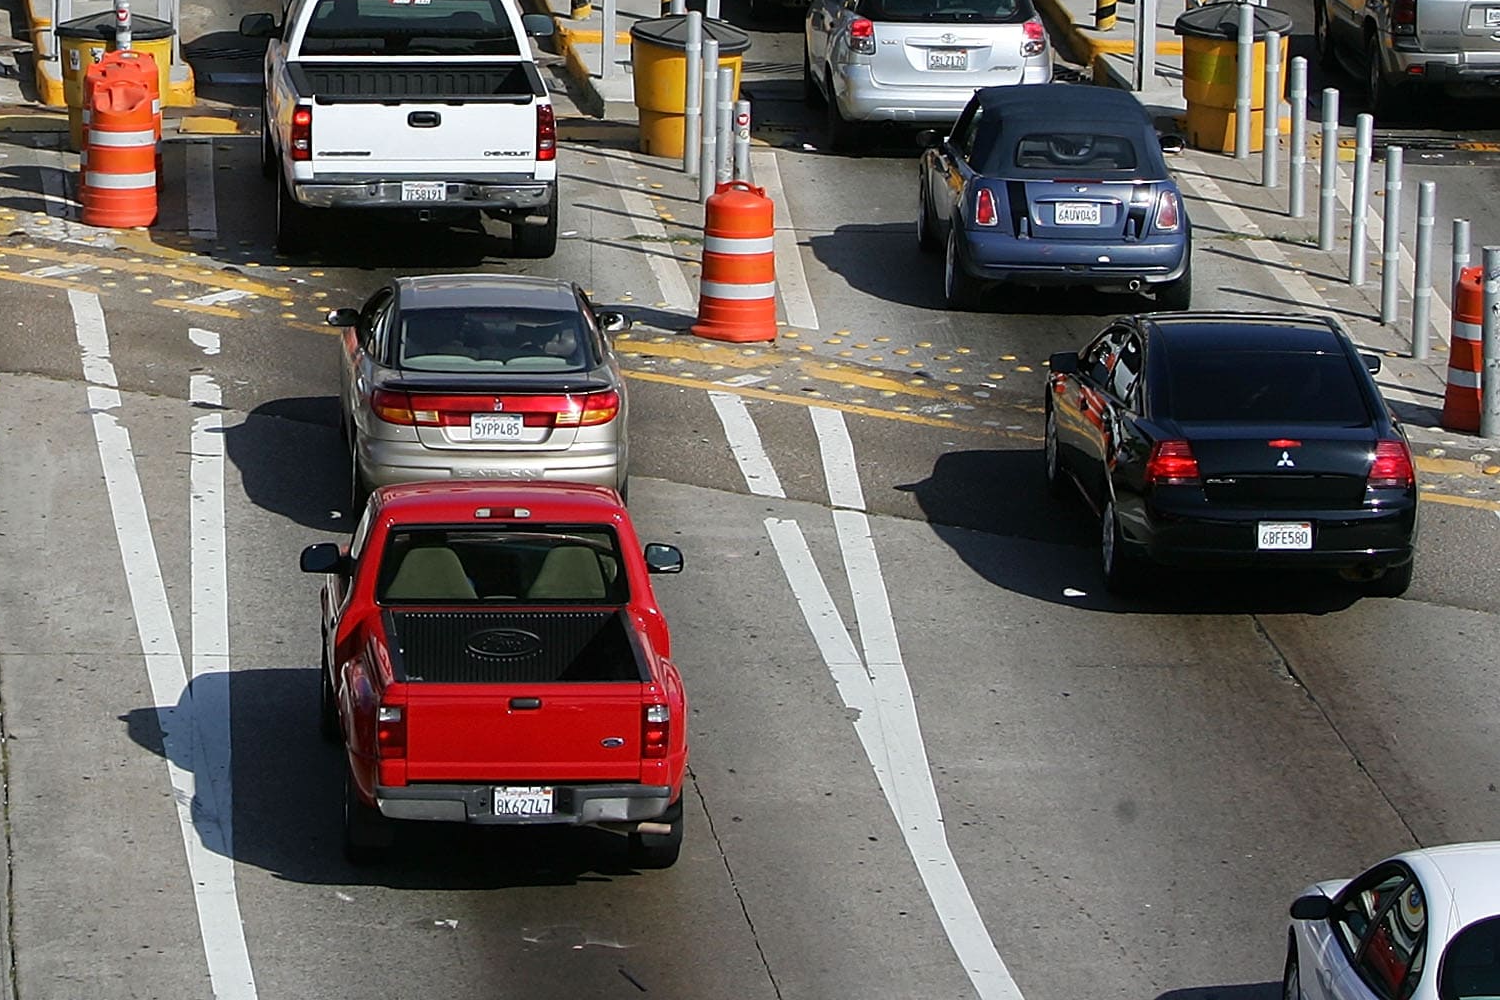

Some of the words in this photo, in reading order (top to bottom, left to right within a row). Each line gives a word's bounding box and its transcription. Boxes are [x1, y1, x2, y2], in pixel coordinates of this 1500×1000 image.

[405, 189, 443, 201] 7F58191
[474, 422, 520, 436] 5YPP485
[1262, 531, 1308, 545] 6BFE580
[496, 799, 551, 815] 8K62747
